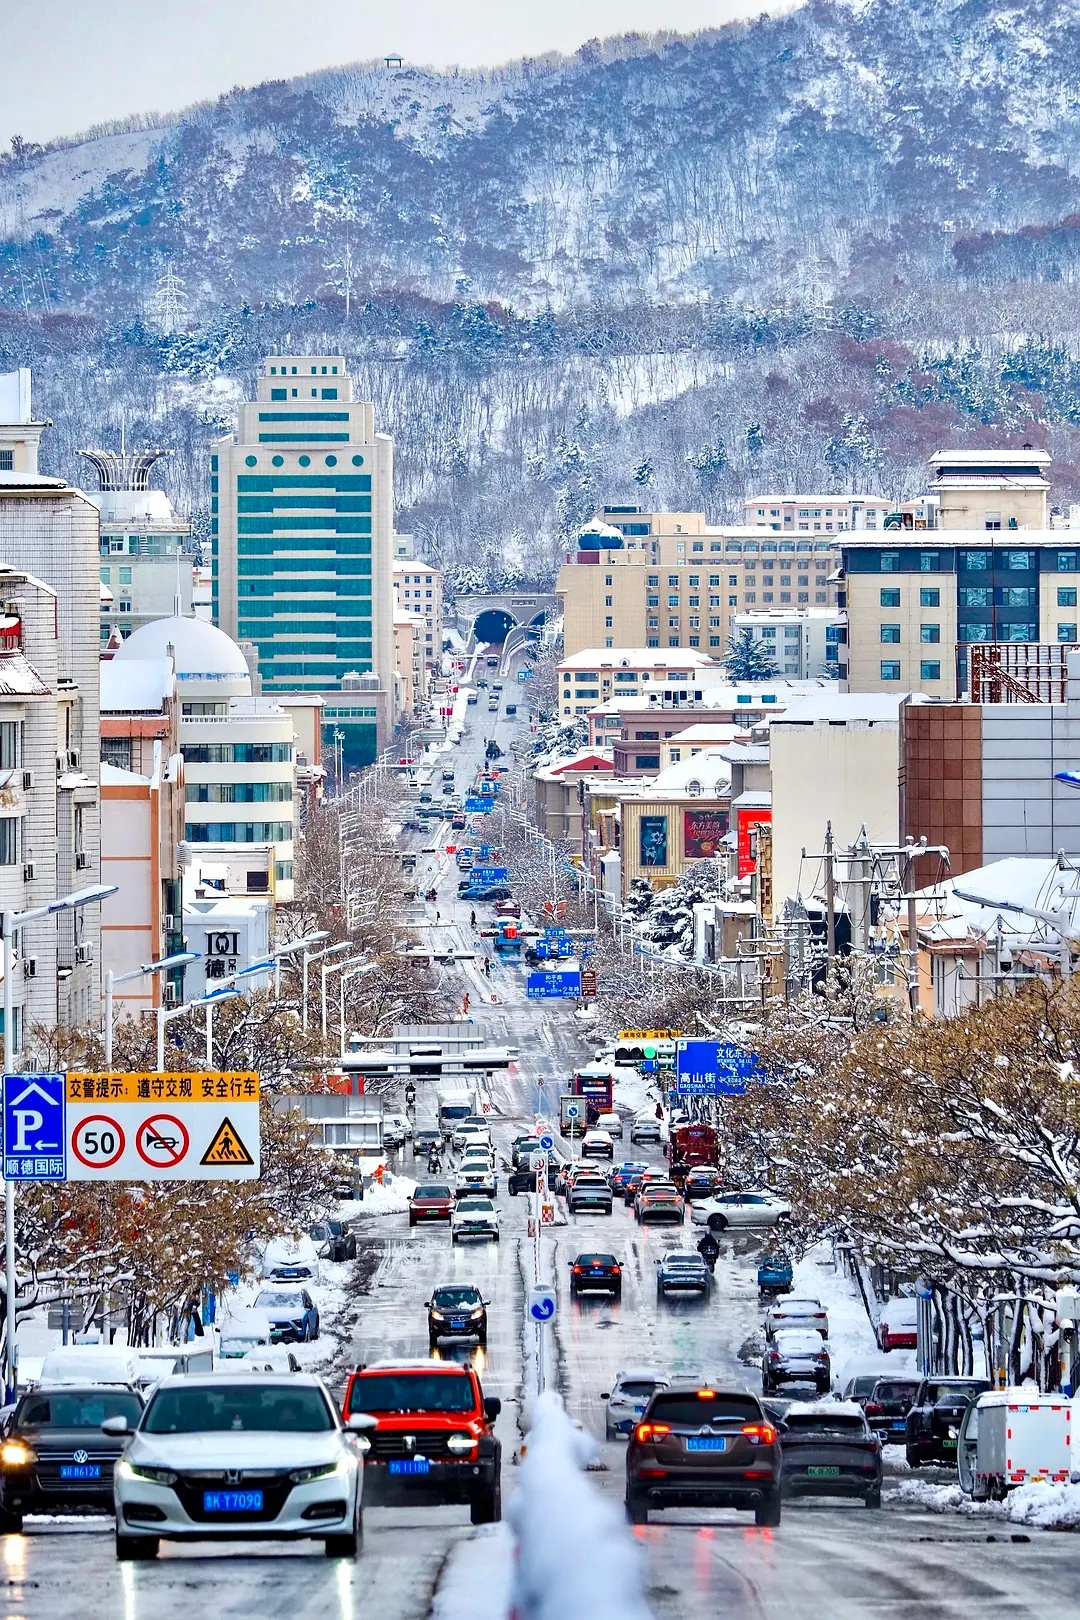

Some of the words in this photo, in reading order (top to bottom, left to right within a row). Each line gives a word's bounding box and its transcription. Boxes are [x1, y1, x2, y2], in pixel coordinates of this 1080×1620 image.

[137, 1078, 193, 1098] 遵守交规
[201, 1078, 256, 1098] 安全行车
[679, 1072, 716, 1084] 高山街
[12, 1109, 43, 1151] P
[84, 1131, 115, 1155] 50
[5, 1158, 63, 1176] 顺德国际
